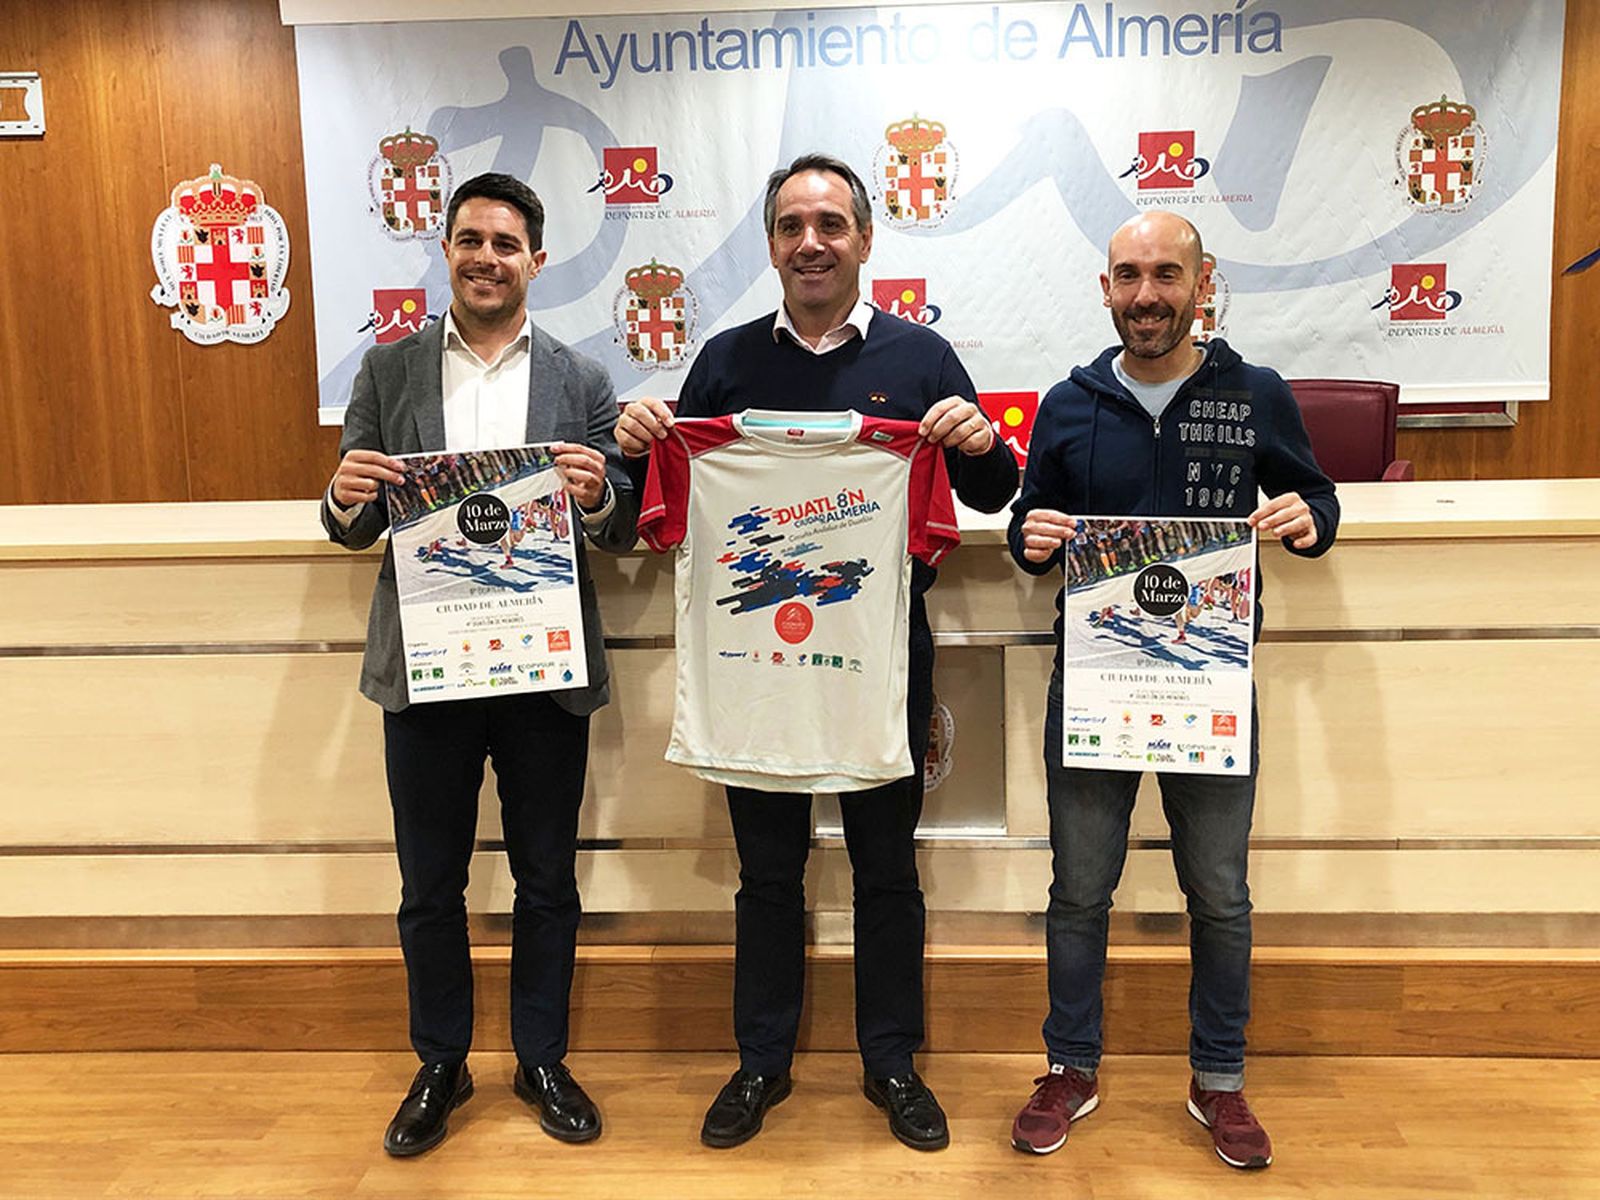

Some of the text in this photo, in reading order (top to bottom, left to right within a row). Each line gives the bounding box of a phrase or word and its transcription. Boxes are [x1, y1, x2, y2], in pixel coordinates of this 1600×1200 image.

[552, 0, 1283, 89] Ayuntamiento de Almería
[1136, 195, 1190, 205] DEPORTES
[1192, 195, 1205, 204] DE
[604, 209, 656, 220] DEPORTES
[657, 209, 671, 219] DE
[1387, 326, 1442, 337] DEPORTES
[1443, 326, 1457, 335] DE
[1189, 399, 1252, 422] CHEAP
[1178, 422, 1256, 447] THRILLS
[466, 503, 502, 519] 10 de
[826, 500, 882, 523] ALMERÍA
[464, 518, 511, 533] Marzo
[1144, 574, 1182, 590] 10 de
[1141, 589, 1188, 603] Marzo
[436, 595, 544, 614] CIUDAD DE ALMERÍA
[1100, 673, 1143, 683] CIUDAD
[1145, 674, 1158, 684] DE
